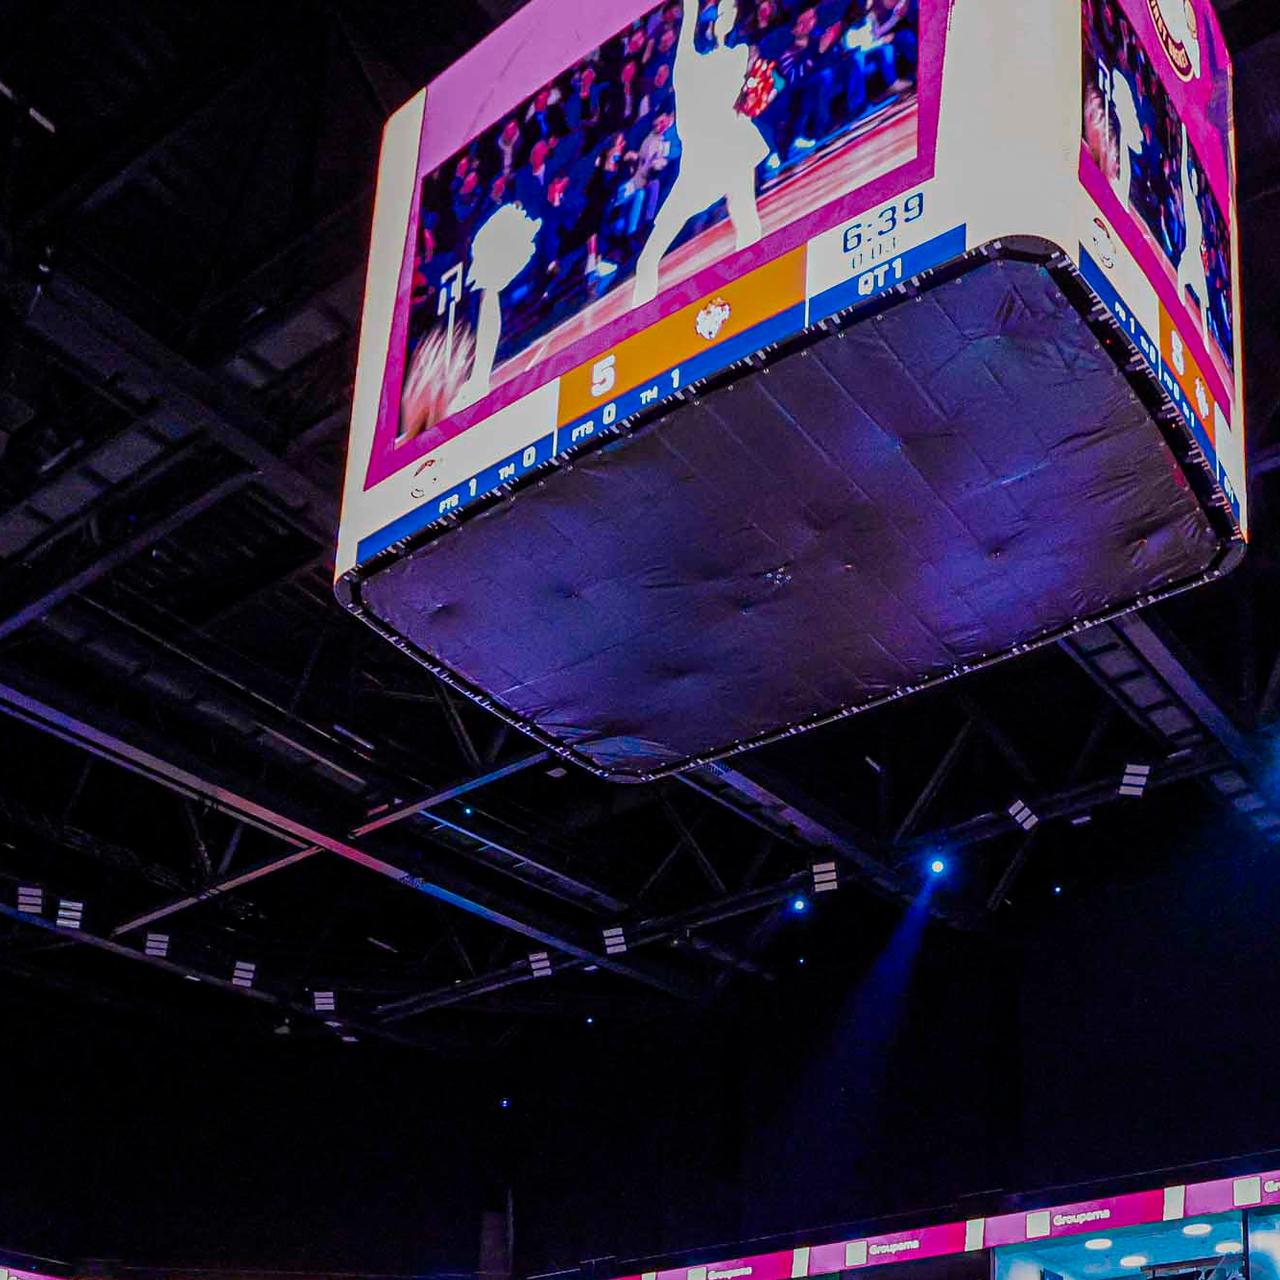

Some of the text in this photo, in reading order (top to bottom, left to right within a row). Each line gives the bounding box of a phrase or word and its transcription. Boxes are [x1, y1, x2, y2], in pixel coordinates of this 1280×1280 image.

[843, 192, 924, 253] 6:39
[572, 368, 679, 441] FTS 0 TM 1
[591, 354, 616, 397] 5
[439, 447, 535, 513] FTS 1 TM 0
